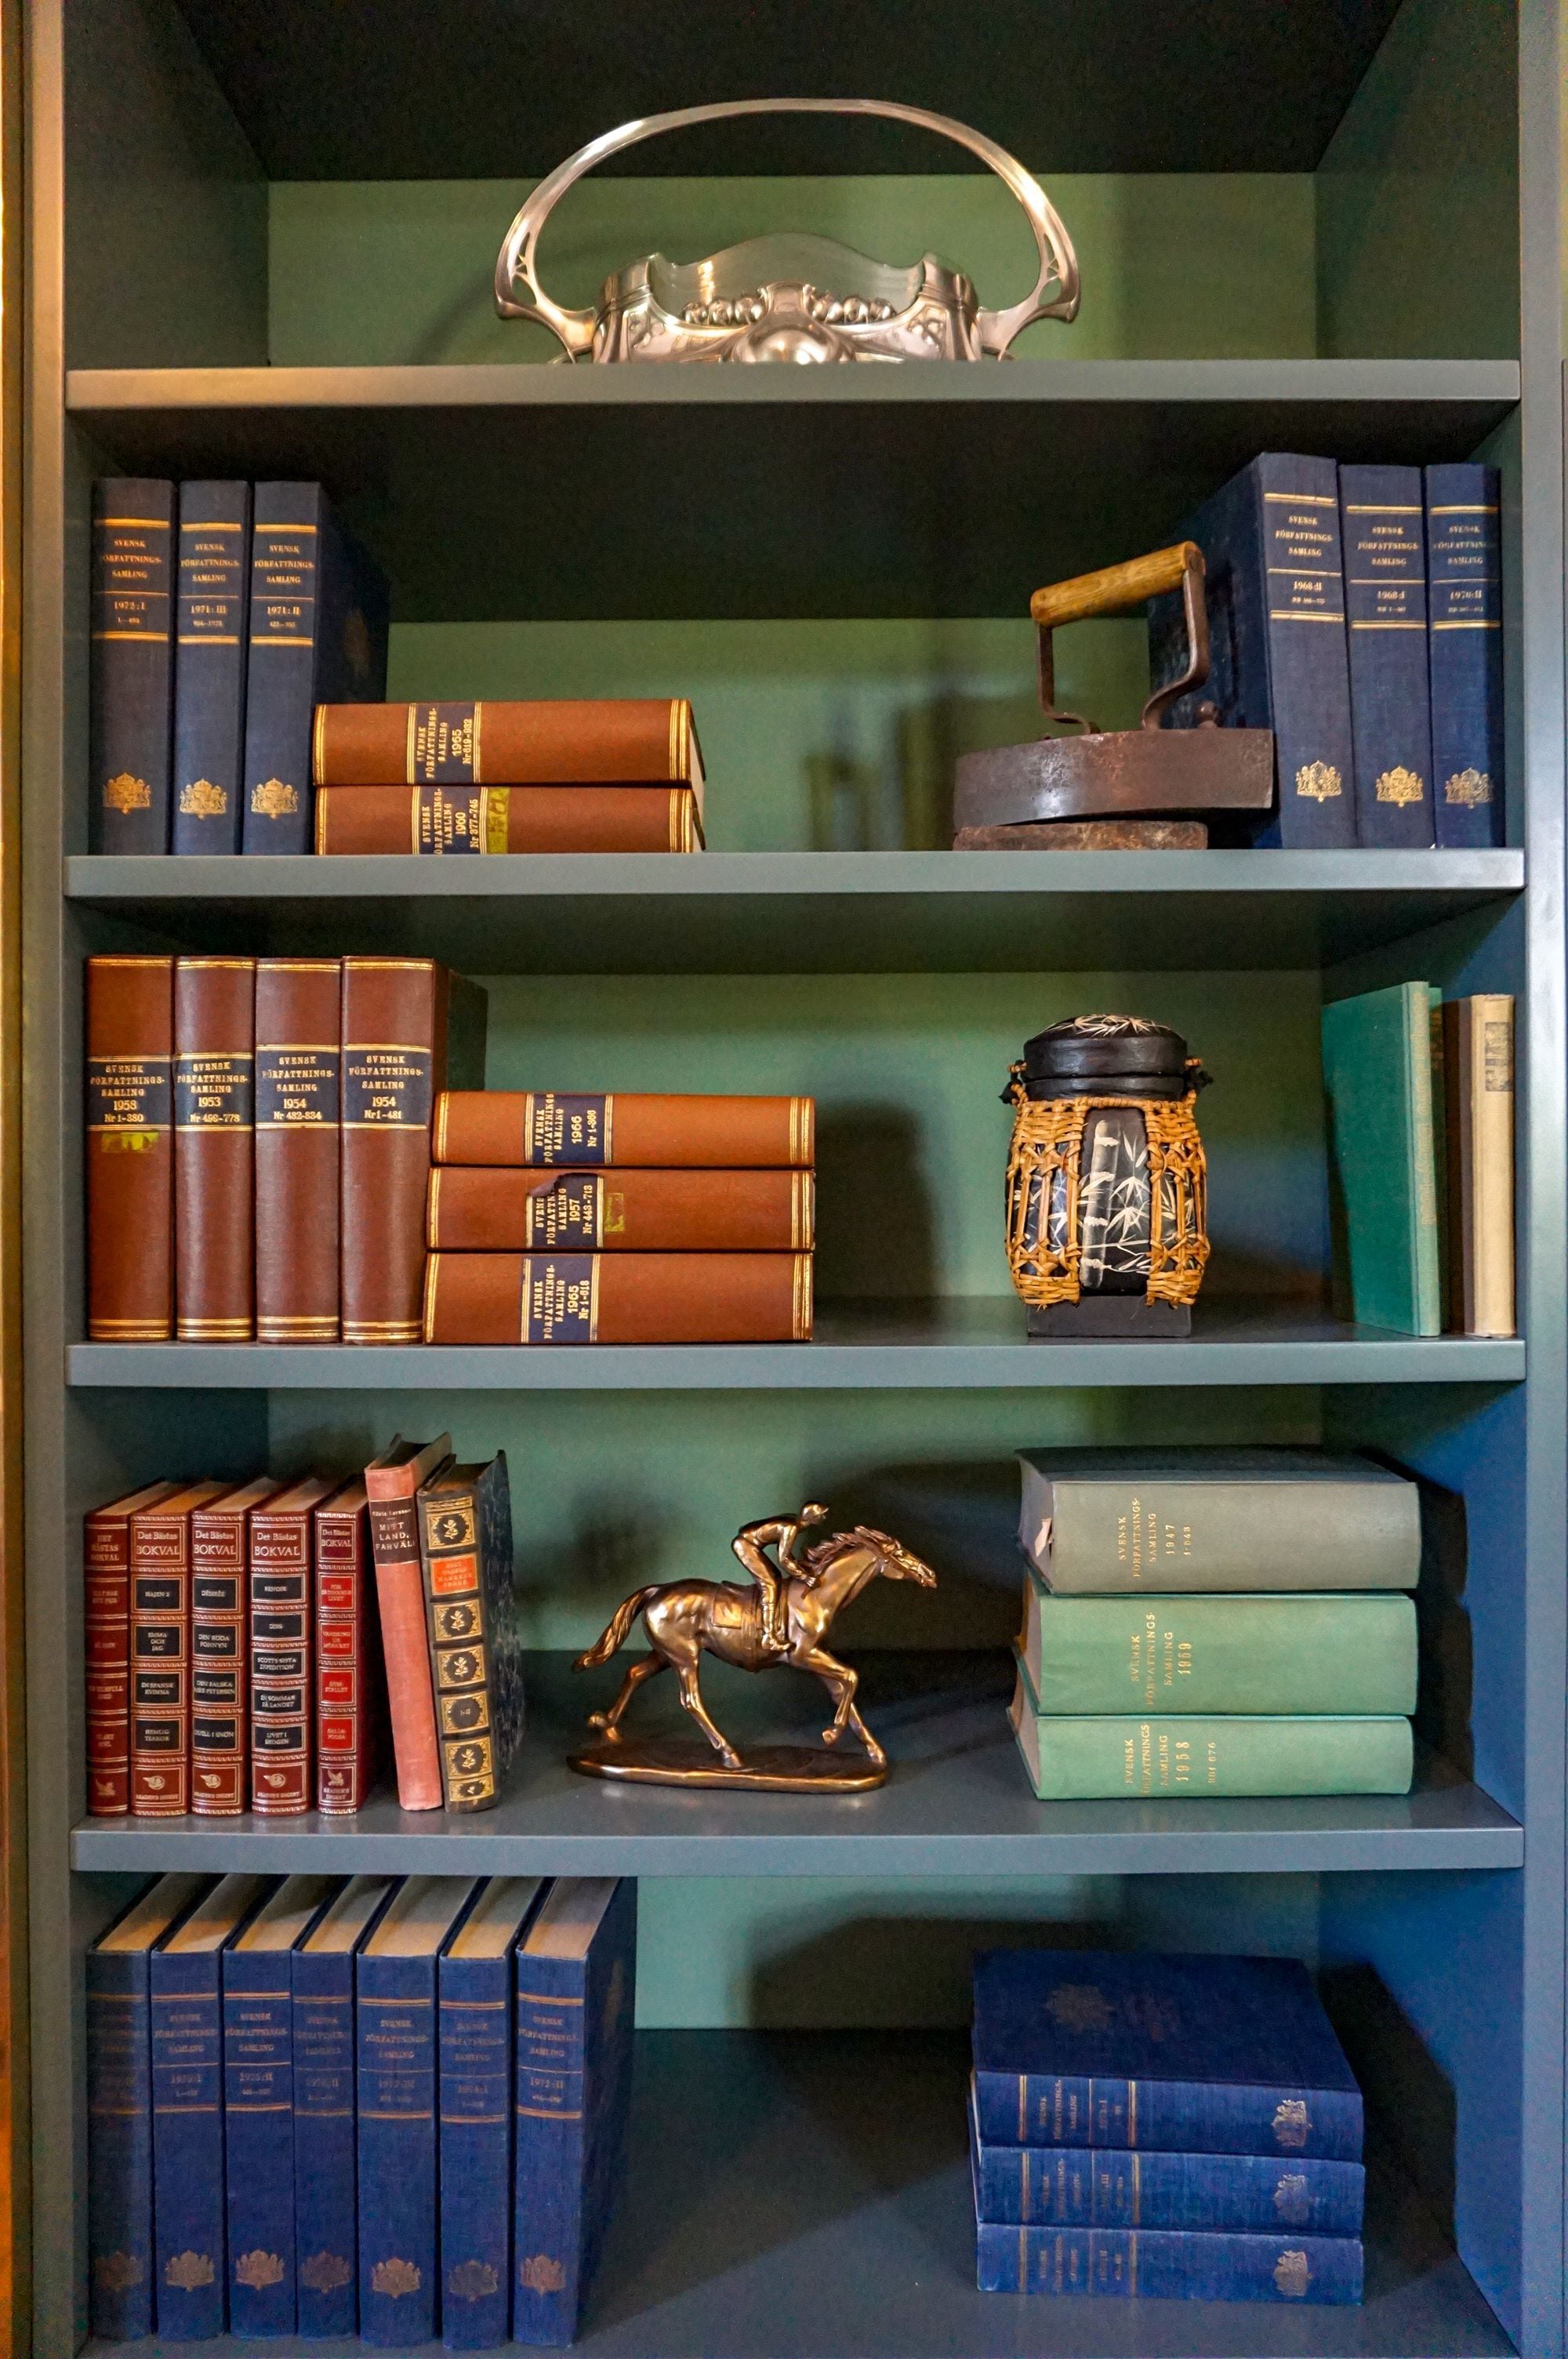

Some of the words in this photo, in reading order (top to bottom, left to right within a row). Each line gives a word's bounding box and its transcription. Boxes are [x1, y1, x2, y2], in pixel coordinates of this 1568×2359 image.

[1288, 515, 1318, 526] SVENSK
[194, 543, 225, 552] SVENSK
[269, 544, 300, 554] SVENSK
[1288, 547, 1322, 558] SAMLING
[1371, 558, 1406, 566] SAMLING
[111, 569, 148, 579] SAMLING
[437, 722, 448, 762] SAMLING
[452, 729, 463, 757] 1965
[421, 805, 430, 843] SVENSK
[444, 803, 452, 845] SAMLING
[455, 812, 466, 835] 1960
[470, 836, 479, 849] Nr
[278, 1056, 317, 1065] SVENSK
[366, 1056, 405, 1064] SVENSK
[105, 1064, 144, 1073] SVENSK
[193, 1061, 231, 1072] SVENSK
[101, 1088, 145, 1097] SAMLING
[113, 1100, 137, 1111] 1958
[198, 1096, 222, 1108] 1953
[283, 1098, 307, 1109] 1954
[372, 1096, 397, 1107] 1954
[104, 1113, 115, 1122] Nr
[190, 1113, 201, 1122] Nr
[274, 1111, 285, 1120] Nr
[535, 1109, 545, 1147] SVENSK
[554, 1108, 564, 1150] SAMLING
[571, 1115, 583, 1143] 1966
[586, 1137, 597, 1147] Nr
[558, 1187, 567, 1230] SAMLING
[569, 1198, 580, 1222] 1957
[583, 1223, 593, 1234] Nr
[534, 1281, 543, 1319] SVENSK
[554, 1280, 565, 1323] SAMLING
[567, 1285, 579, 1314] 1965
[579, 1308, 589, 1320] Nr
[379, 1521, 405, 1531] MITT
[137, 1531, 151, 1539] Det
[195, 1530, 209, 1539] Det
[209, 1531, 234, 1539] Bästas
[256, 1532, 271, 1541] Det
[272, 1532, 298, 1541] Bästas
[1118, 1516, 1127, 1561] SVENSK
[1165, 1524, 1175, 1555] 1947
[321, 1539, 352, 1547] BOKVAL
[136, 1545, 180, 1556] BOKVAL
[194, 1544, 237, 1555] BOKVAL
[254, 1546, 300, 1557] BOKVAL
[1131, 1635, 1141, 1682] SVENSK
[1164, 1631, 1174, 1686] SAMLING
[1124, 1739, 1134, 1785] SVENSK
[1159, 1735, 1169, 1787] SAMLING
